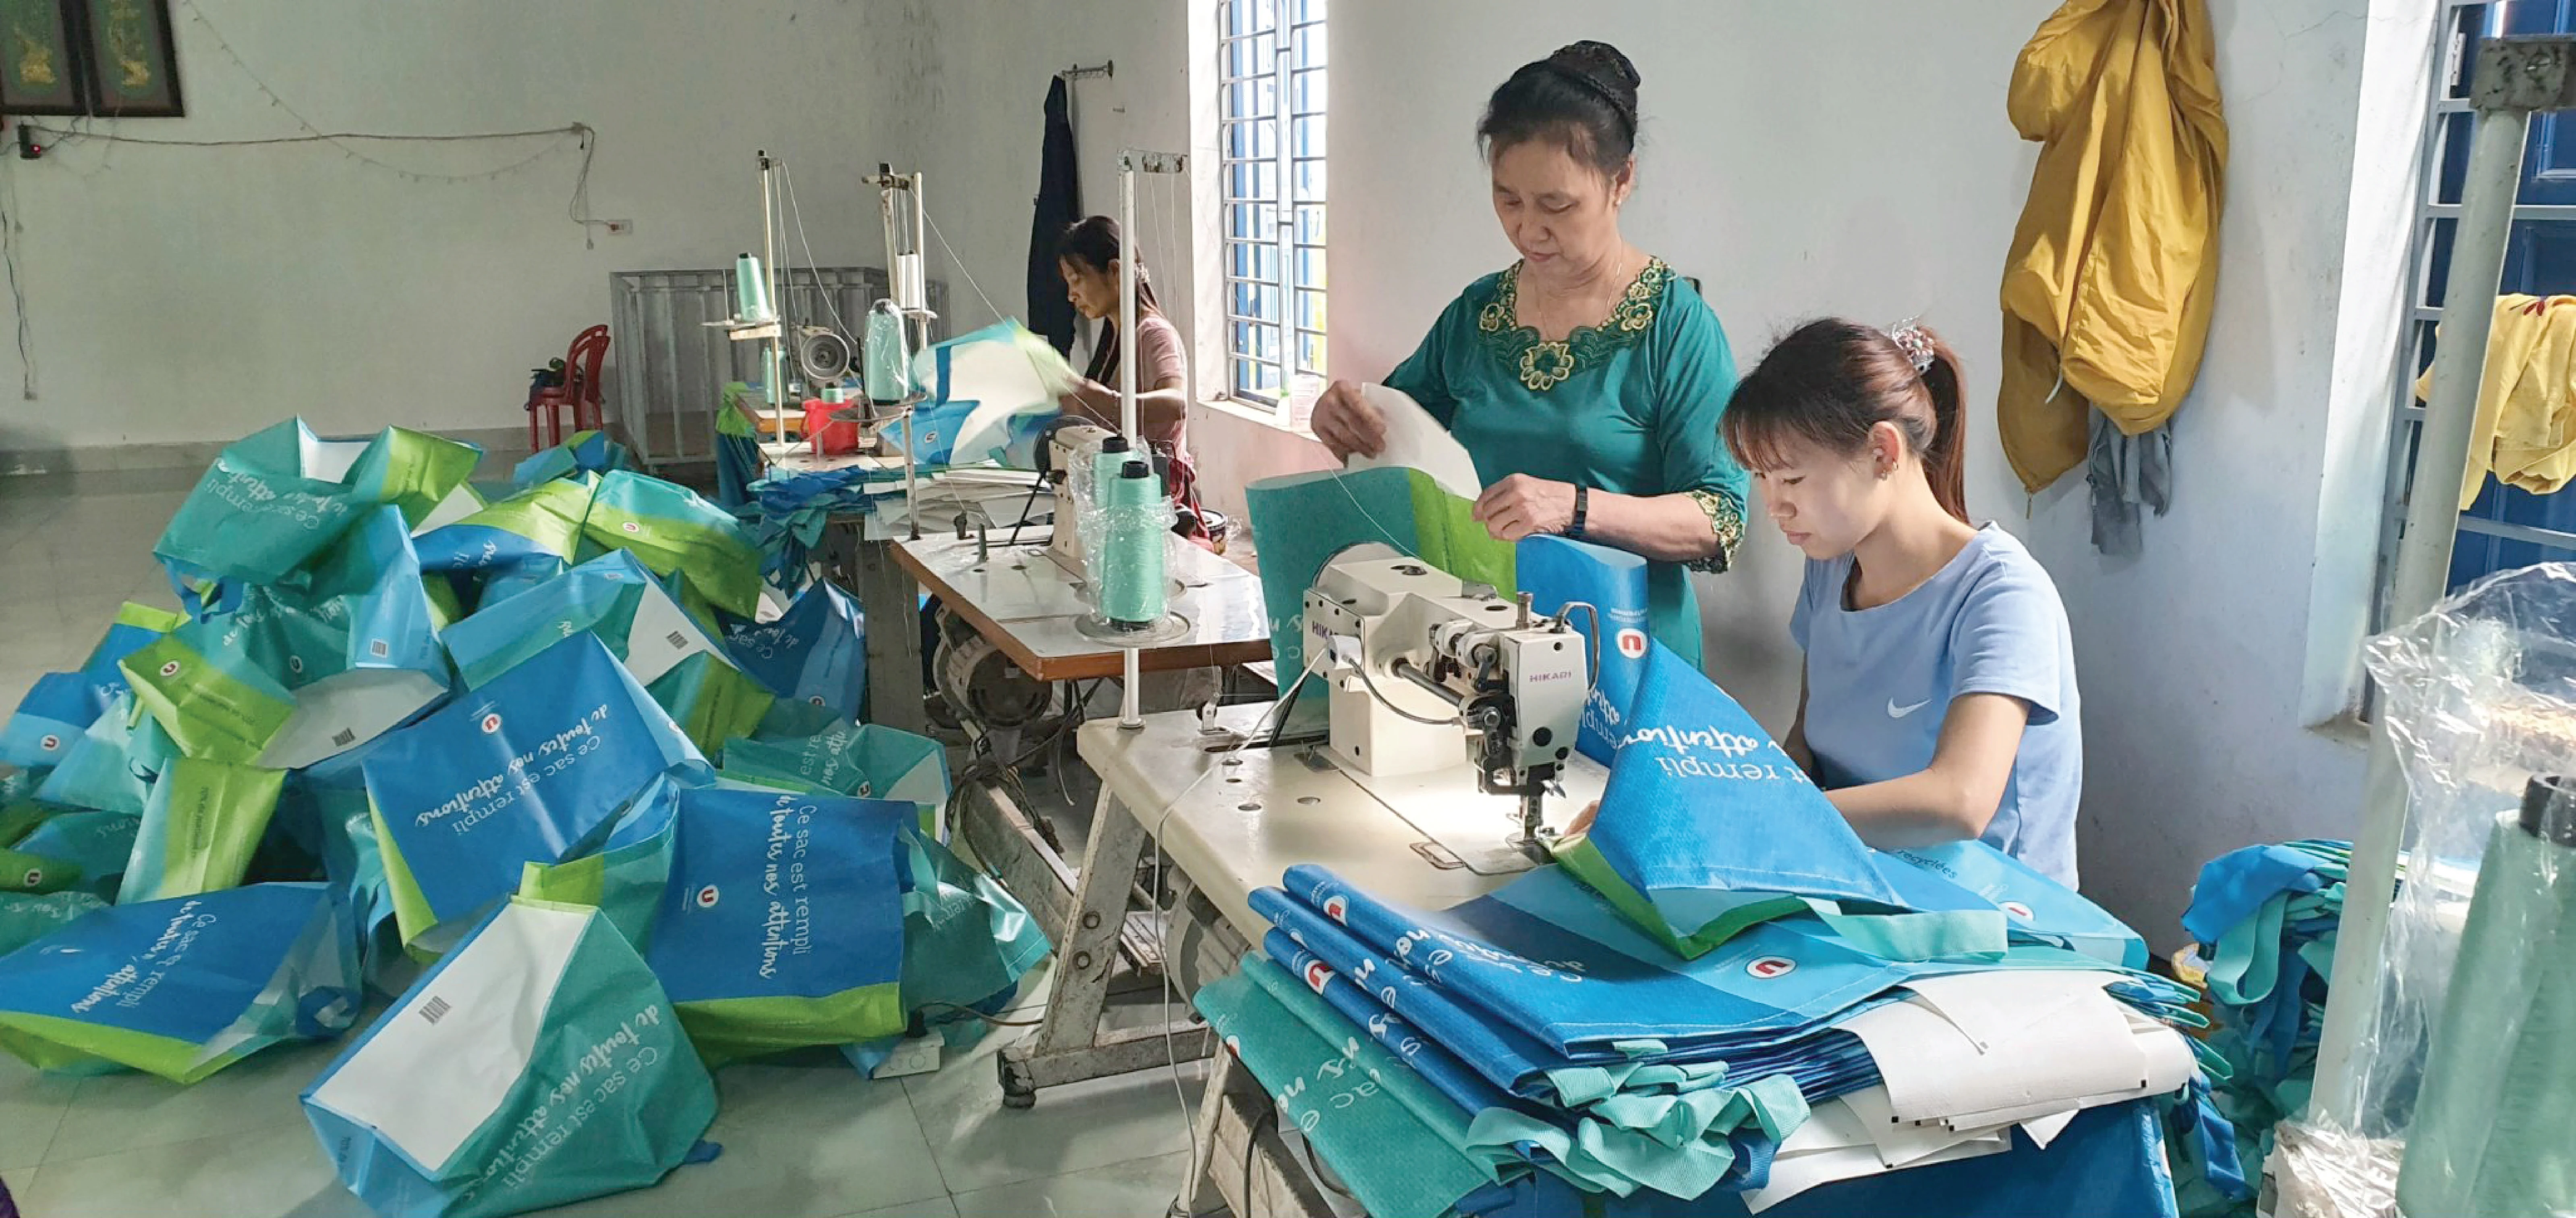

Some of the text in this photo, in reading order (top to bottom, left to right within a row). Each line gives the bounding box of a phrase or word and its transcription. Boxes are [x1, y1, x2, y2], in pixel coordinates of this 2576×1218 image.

[538, 718, 593, 756] toutes
[452, 735, 601, 837] Ce sac est rempli
[1654, 754, 1781, 780] rempli
[415, 771, 504, 828] attentions
[767, 807, 794, 860] toutes
[701, 889, 714, 903] U
[791, 805, 818, 955] Ce sac est rempli
[759, 900, 791, 978] attentions
[635, 1003, 659, 1027] de
[579, 1021, 640, 1075] toutes
[502, 1046, 658, 1189] Ce sac est rempli
